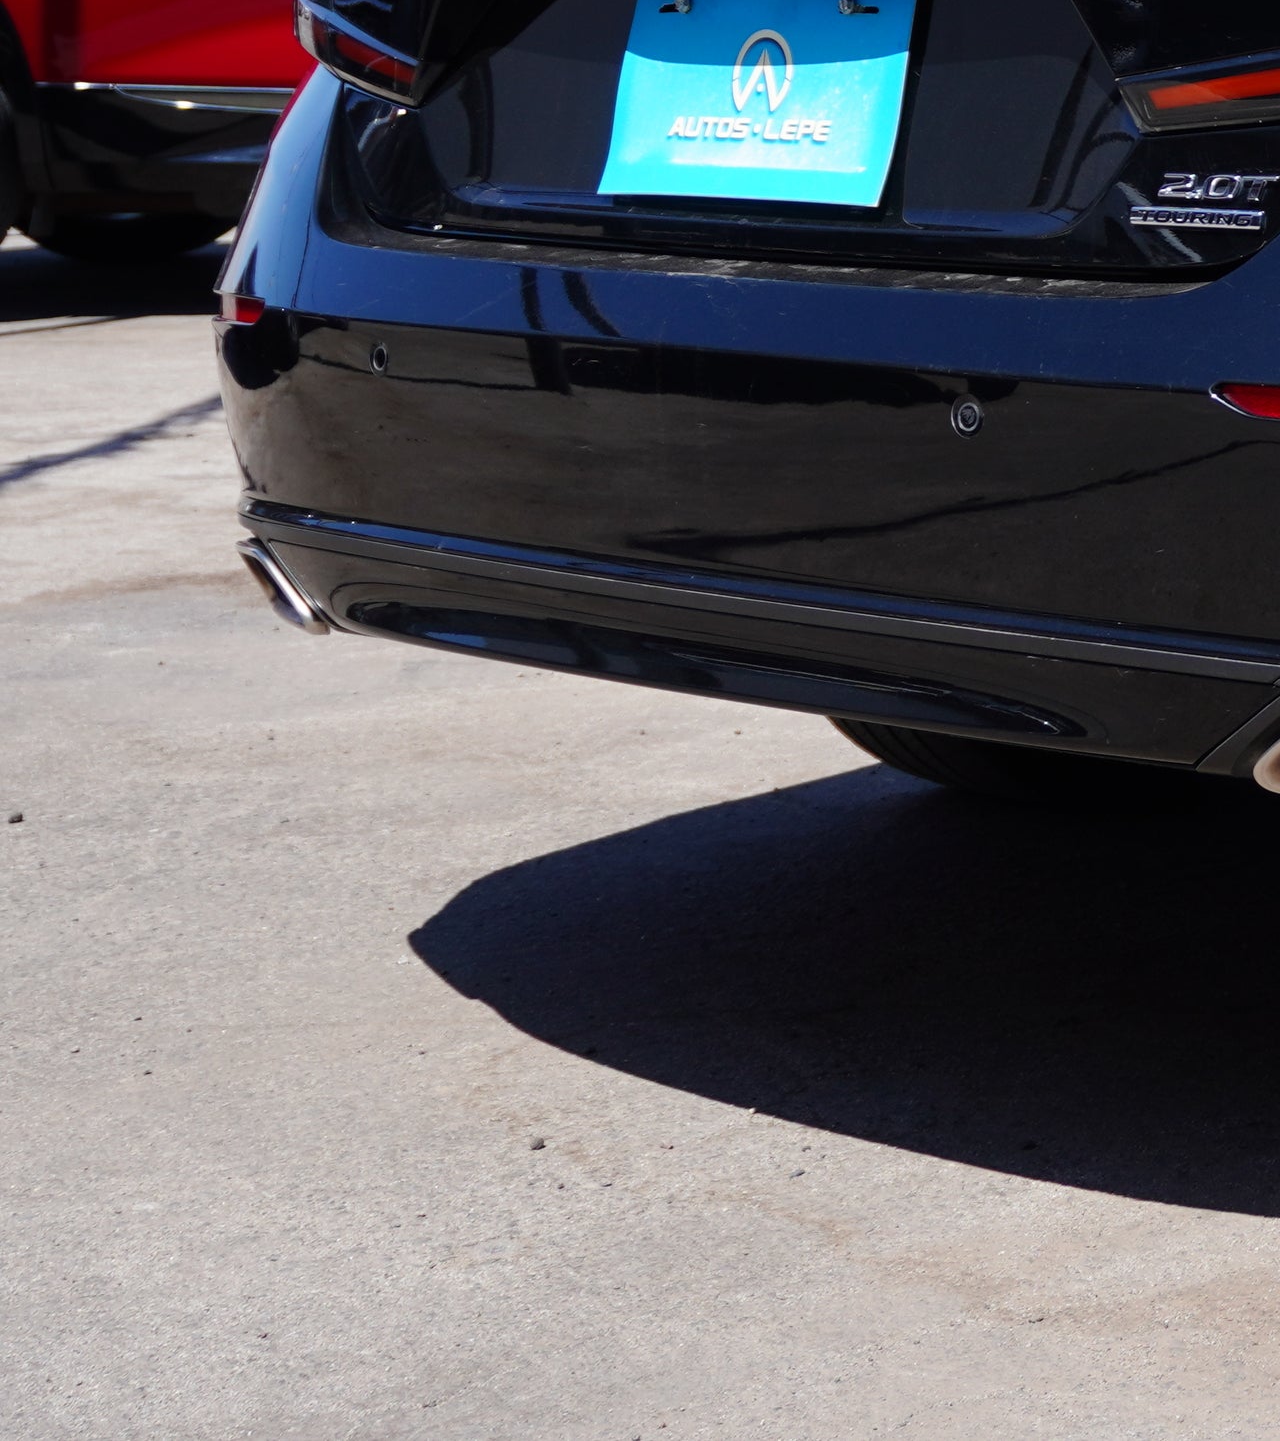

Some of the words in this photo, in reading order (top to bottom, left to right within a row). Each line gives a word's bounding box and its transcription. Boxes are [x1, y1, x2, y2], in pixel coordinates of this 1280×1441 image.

[667, 115, 751, 139] AUTOS
[763, 119, 832, 143] LEPE
[1140, 209, 1254, 227] TOURING
